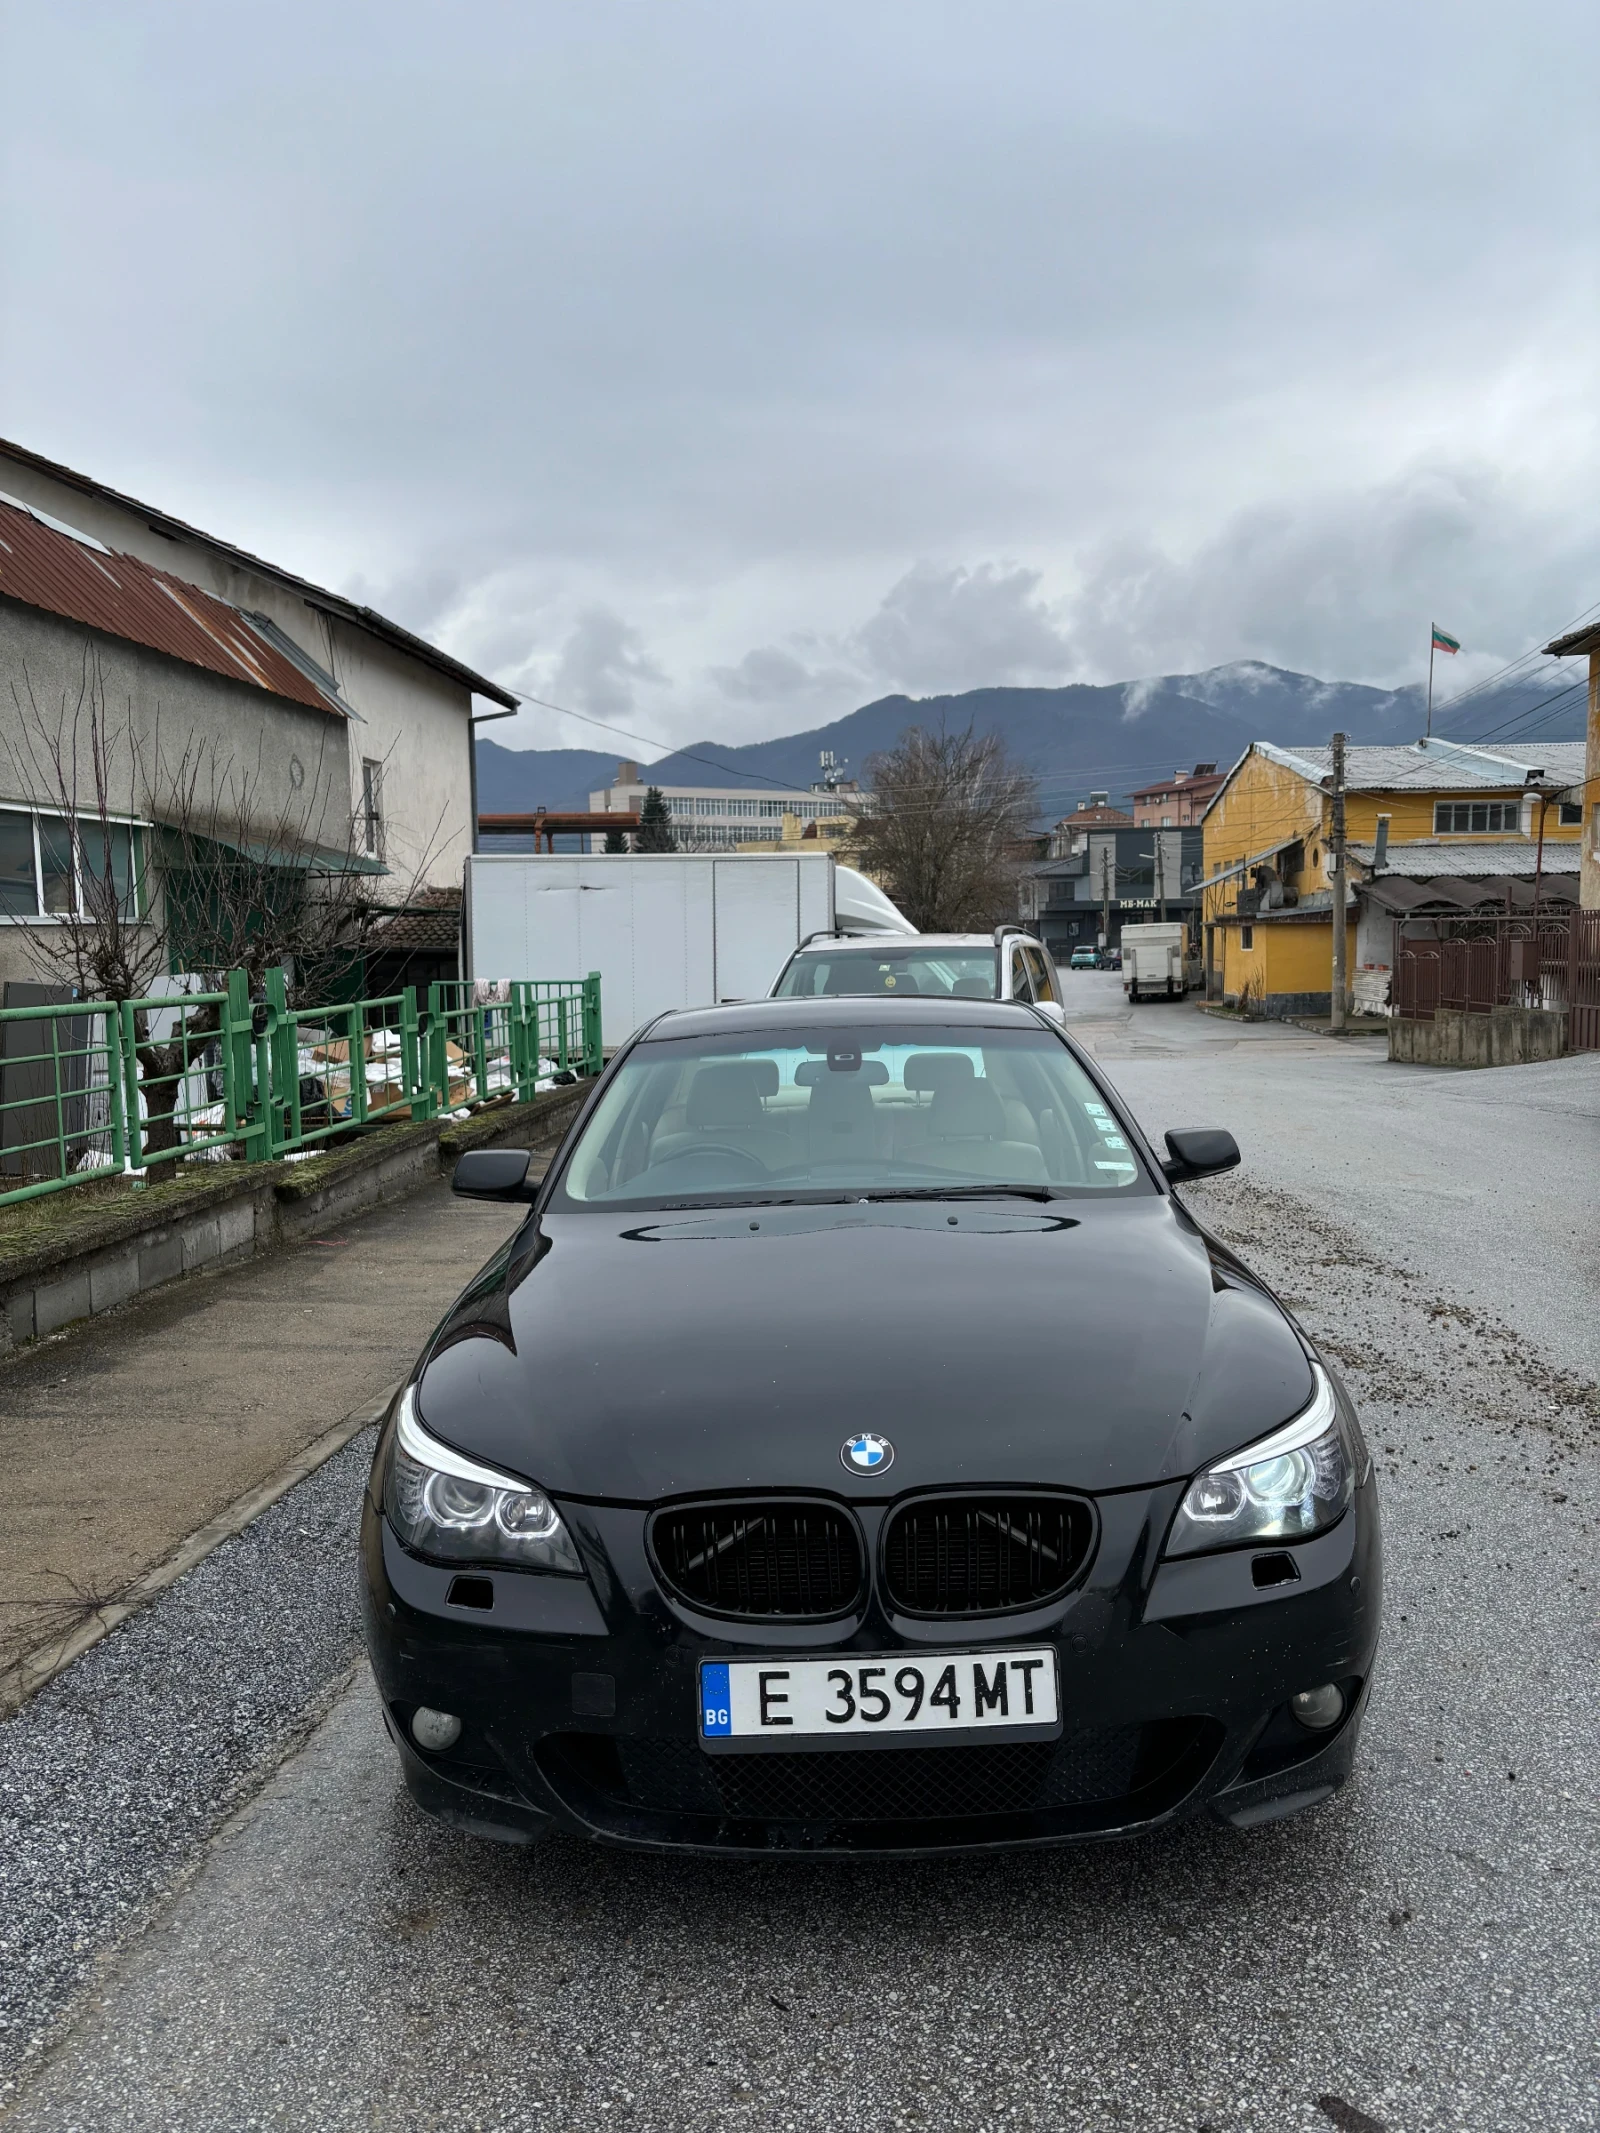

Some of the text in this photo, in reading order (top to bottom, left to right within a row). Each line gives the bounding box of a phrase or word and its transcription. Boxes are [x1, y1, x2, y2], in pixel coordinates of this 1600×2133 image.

[846, 1433, 889, 1447] BMW
[758, 1670, 794, 1726] E
[705, 1708, 729, 1726] BG
